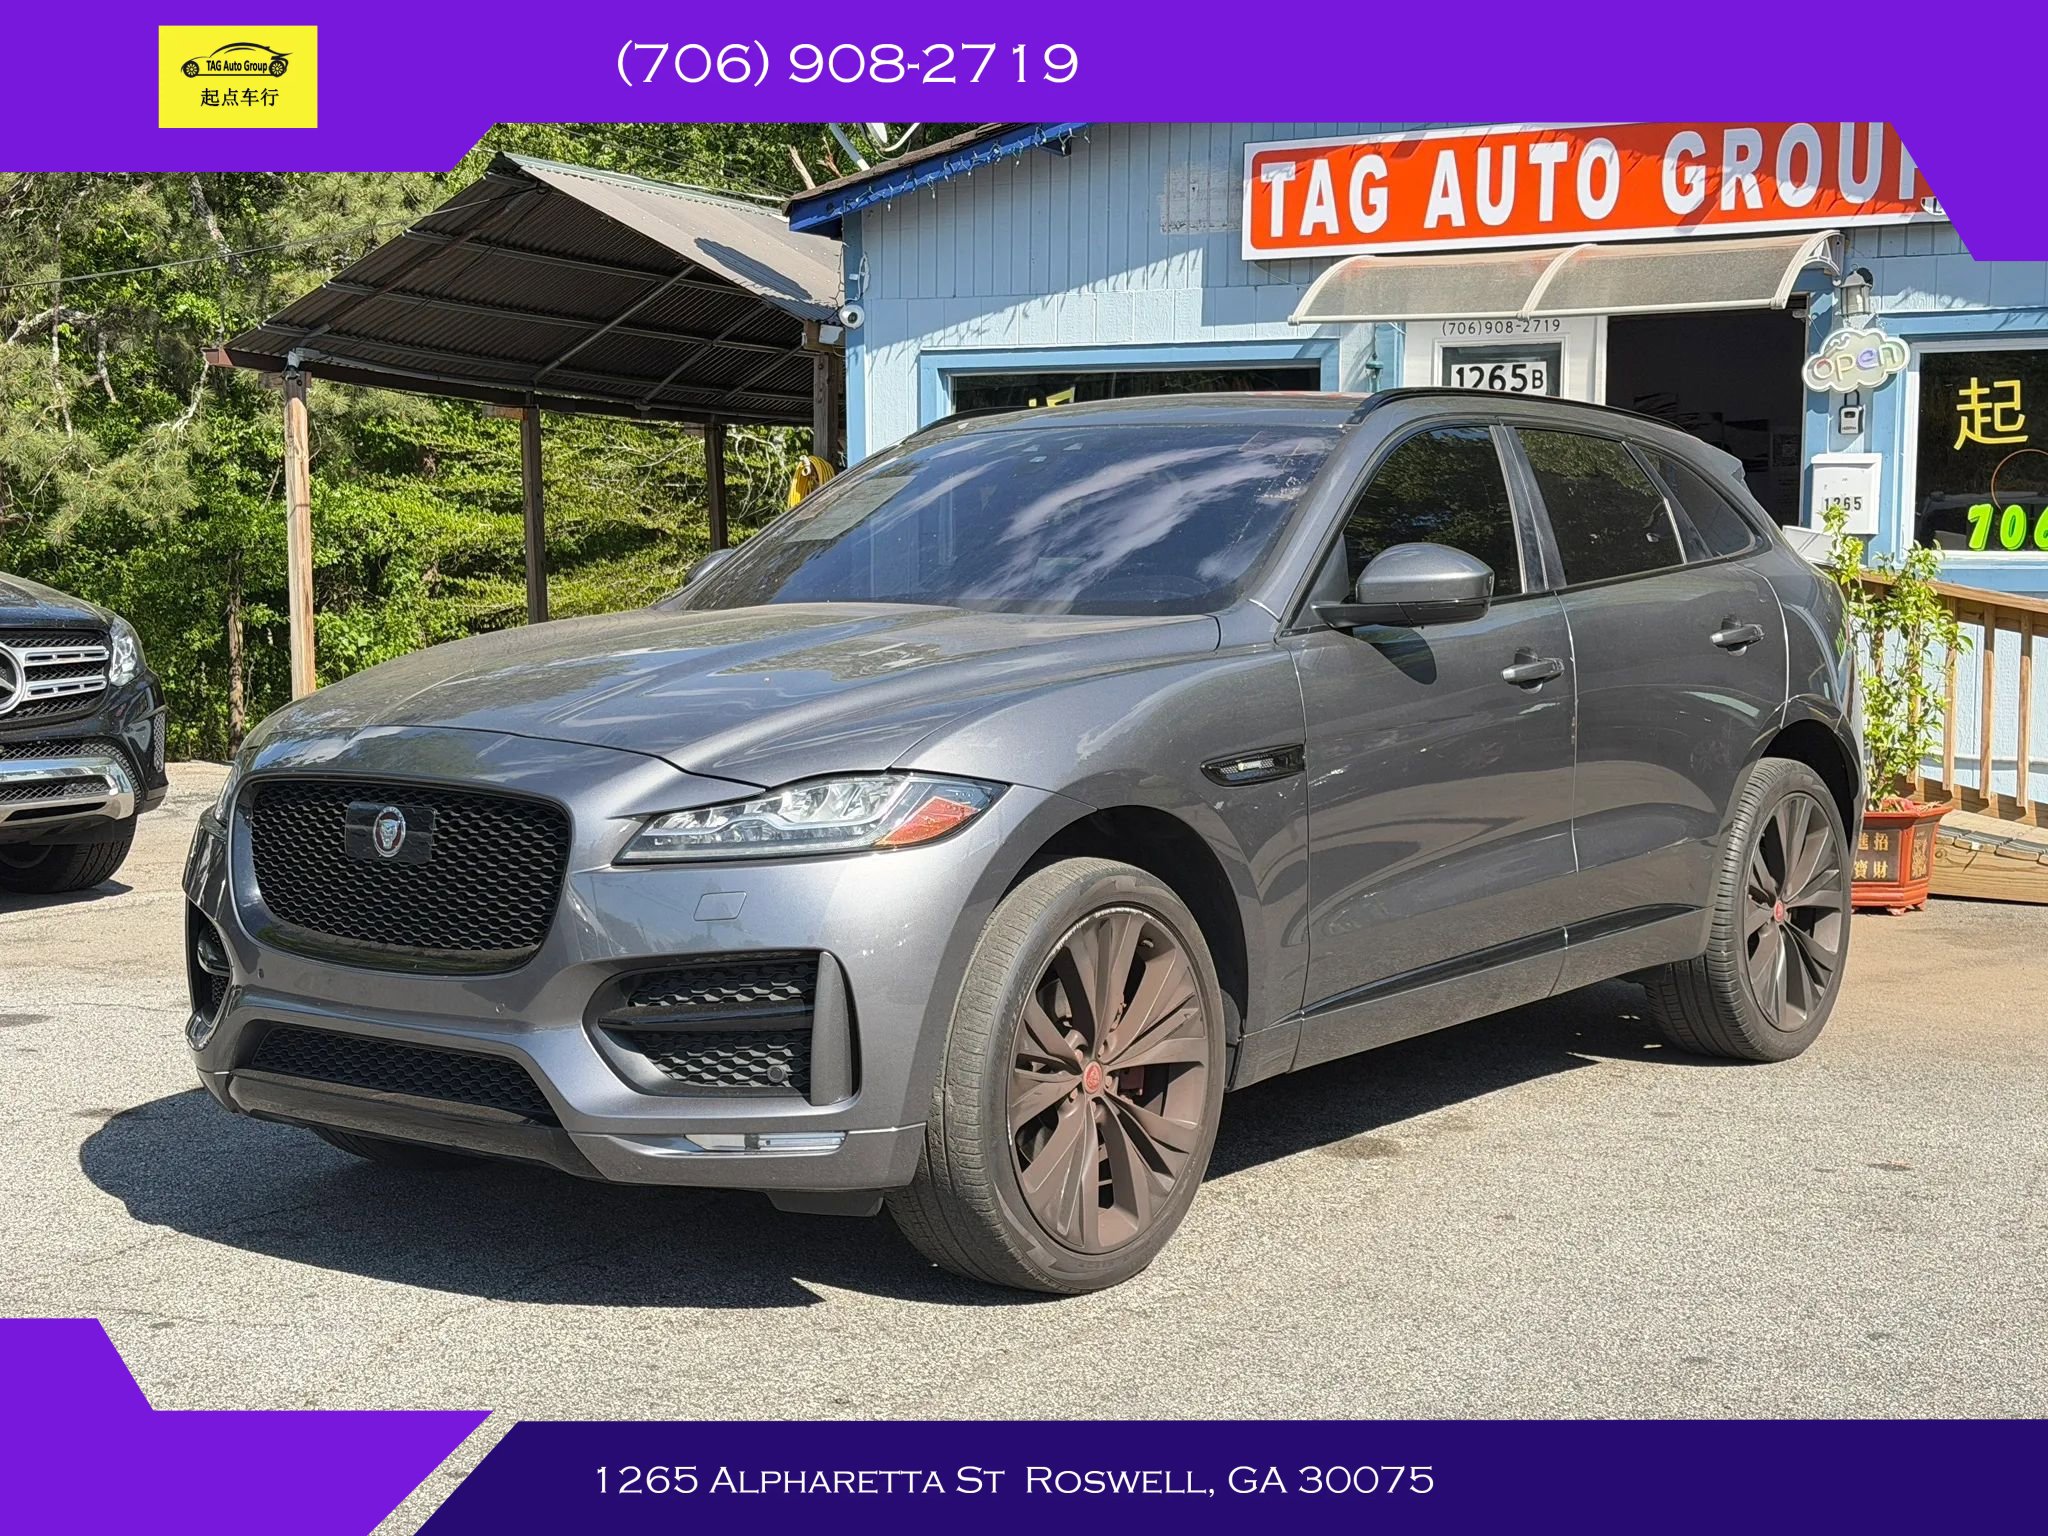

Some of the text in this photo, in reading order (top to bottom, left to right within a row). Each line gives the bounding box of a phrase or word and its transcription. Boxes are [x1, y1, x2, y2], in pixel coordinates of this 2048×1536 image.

[1261, 153, 1389, 238] TAG
[1423, 136, 1621, 230] AUTO
[1441, 318, 1562, 336] (706)908-2719
[1813, 342, 1901, 382] open
[1953, 376, 2030, 451] 起
